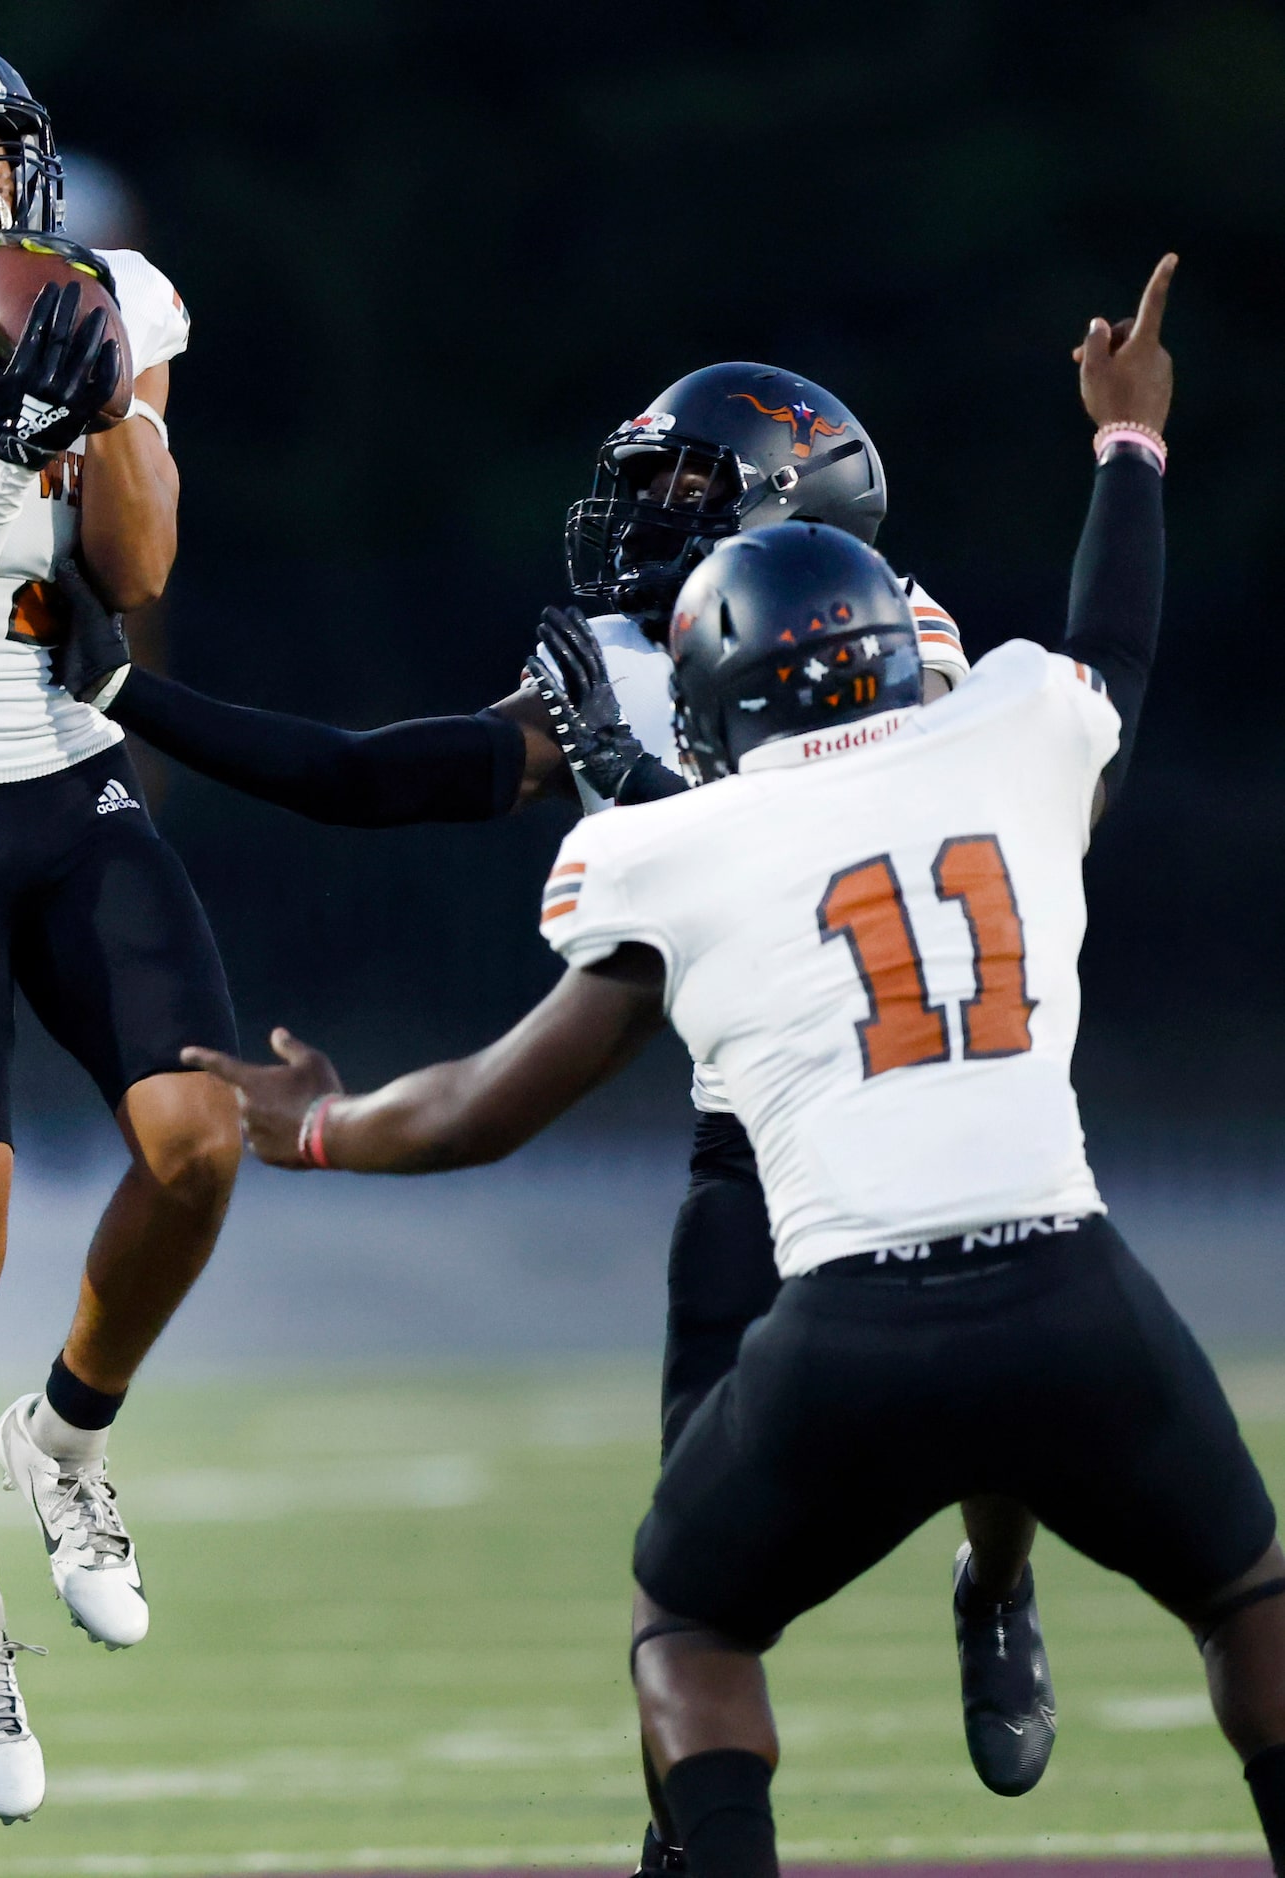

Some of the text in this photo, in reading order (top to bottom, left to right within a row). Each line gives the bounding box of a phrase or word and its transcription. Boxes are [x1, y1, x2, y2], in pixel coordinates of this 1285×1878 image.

[17, 406, 70, 441] adidas
[803, 717, 899, 758] Riddell
[96, 798, 141, 815] adidas
[816, 833, 1039, 1081] 11
